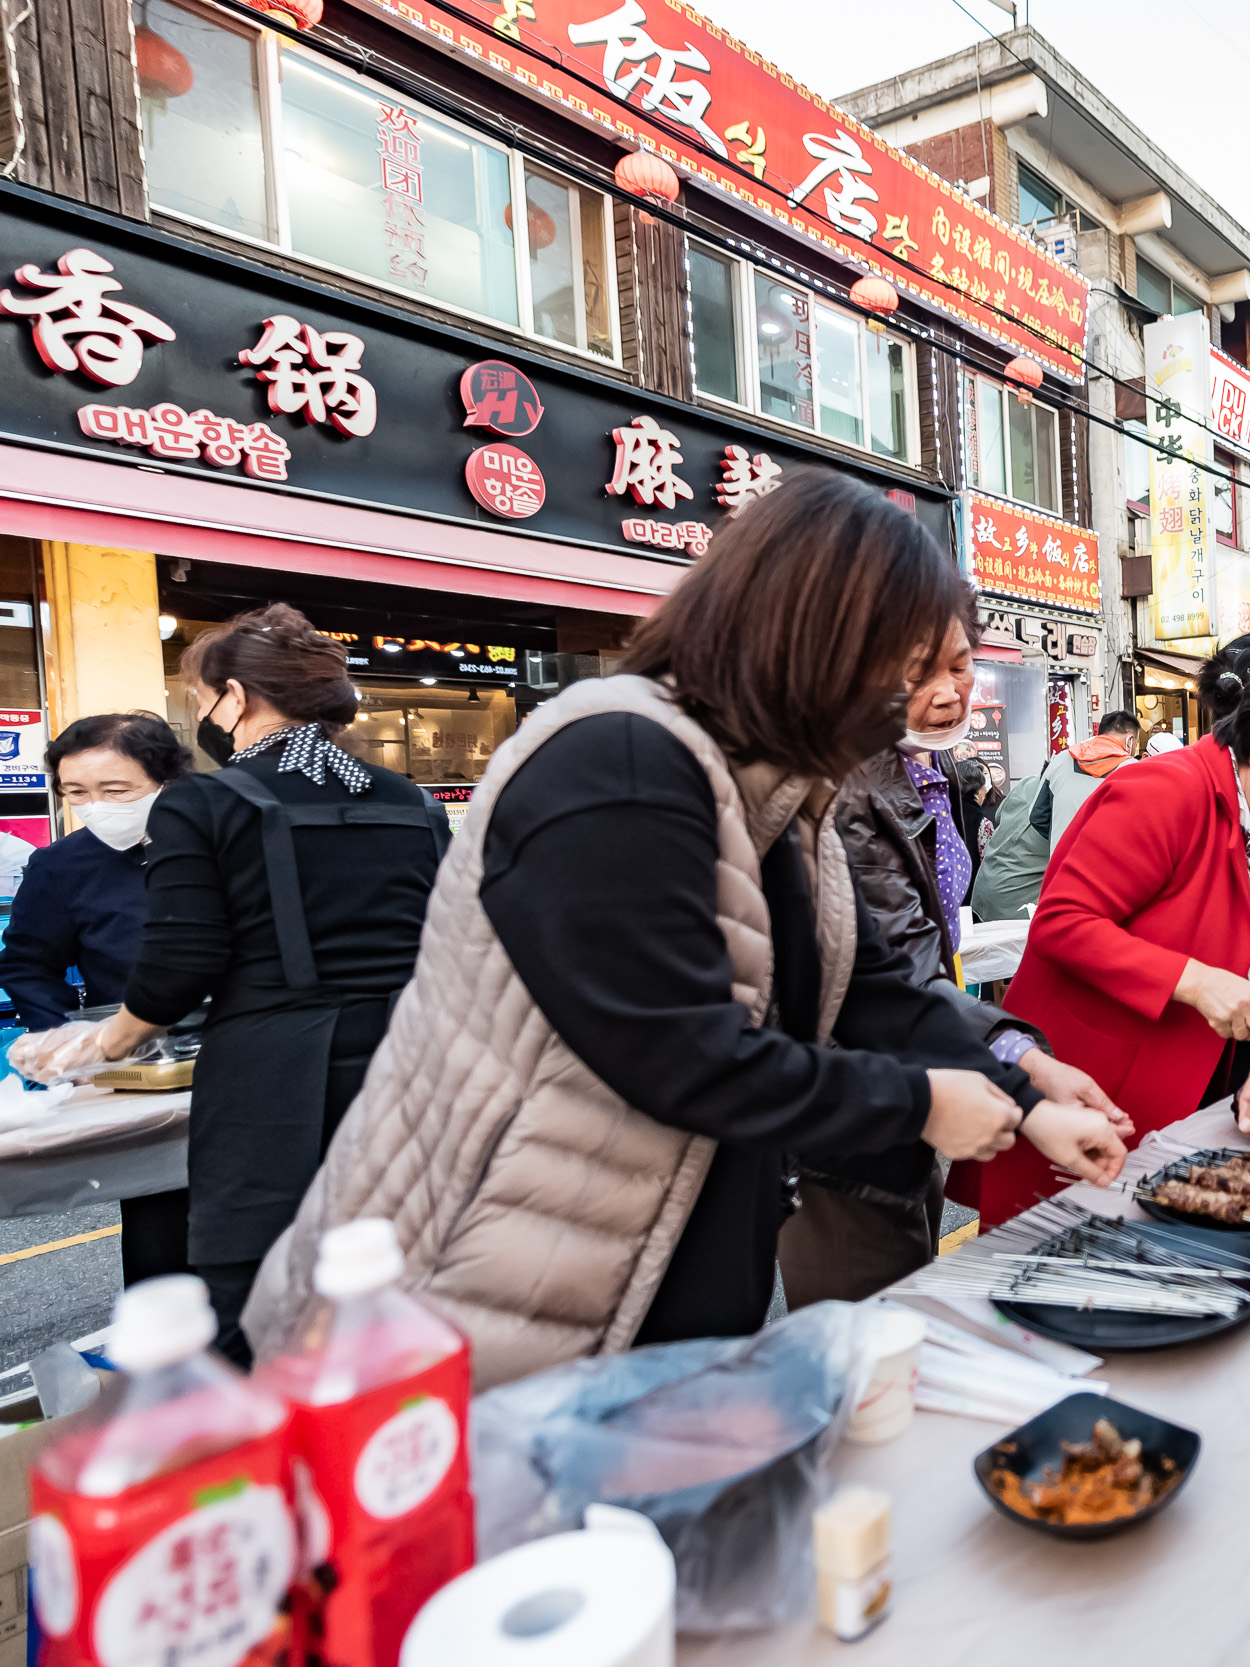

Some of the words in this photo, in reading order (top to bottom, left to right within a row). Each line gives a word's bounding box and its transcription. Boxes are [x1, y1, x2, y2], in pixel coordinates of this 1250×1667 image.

[378, 101, 428, 288] 欢迎团体预约
[0, 248, 377, 437] 香锅
[92, 407, 290, 479] 매운향솥
[483, 450, 541, 490] 매운
[484, 478, 541, 516] 향솥
[633, 521, 714, 554] 마라탕
[974, 514, 1090, 574] 故乡饭店
[1188, 466, 1205, 604] 중화닭날개구이
